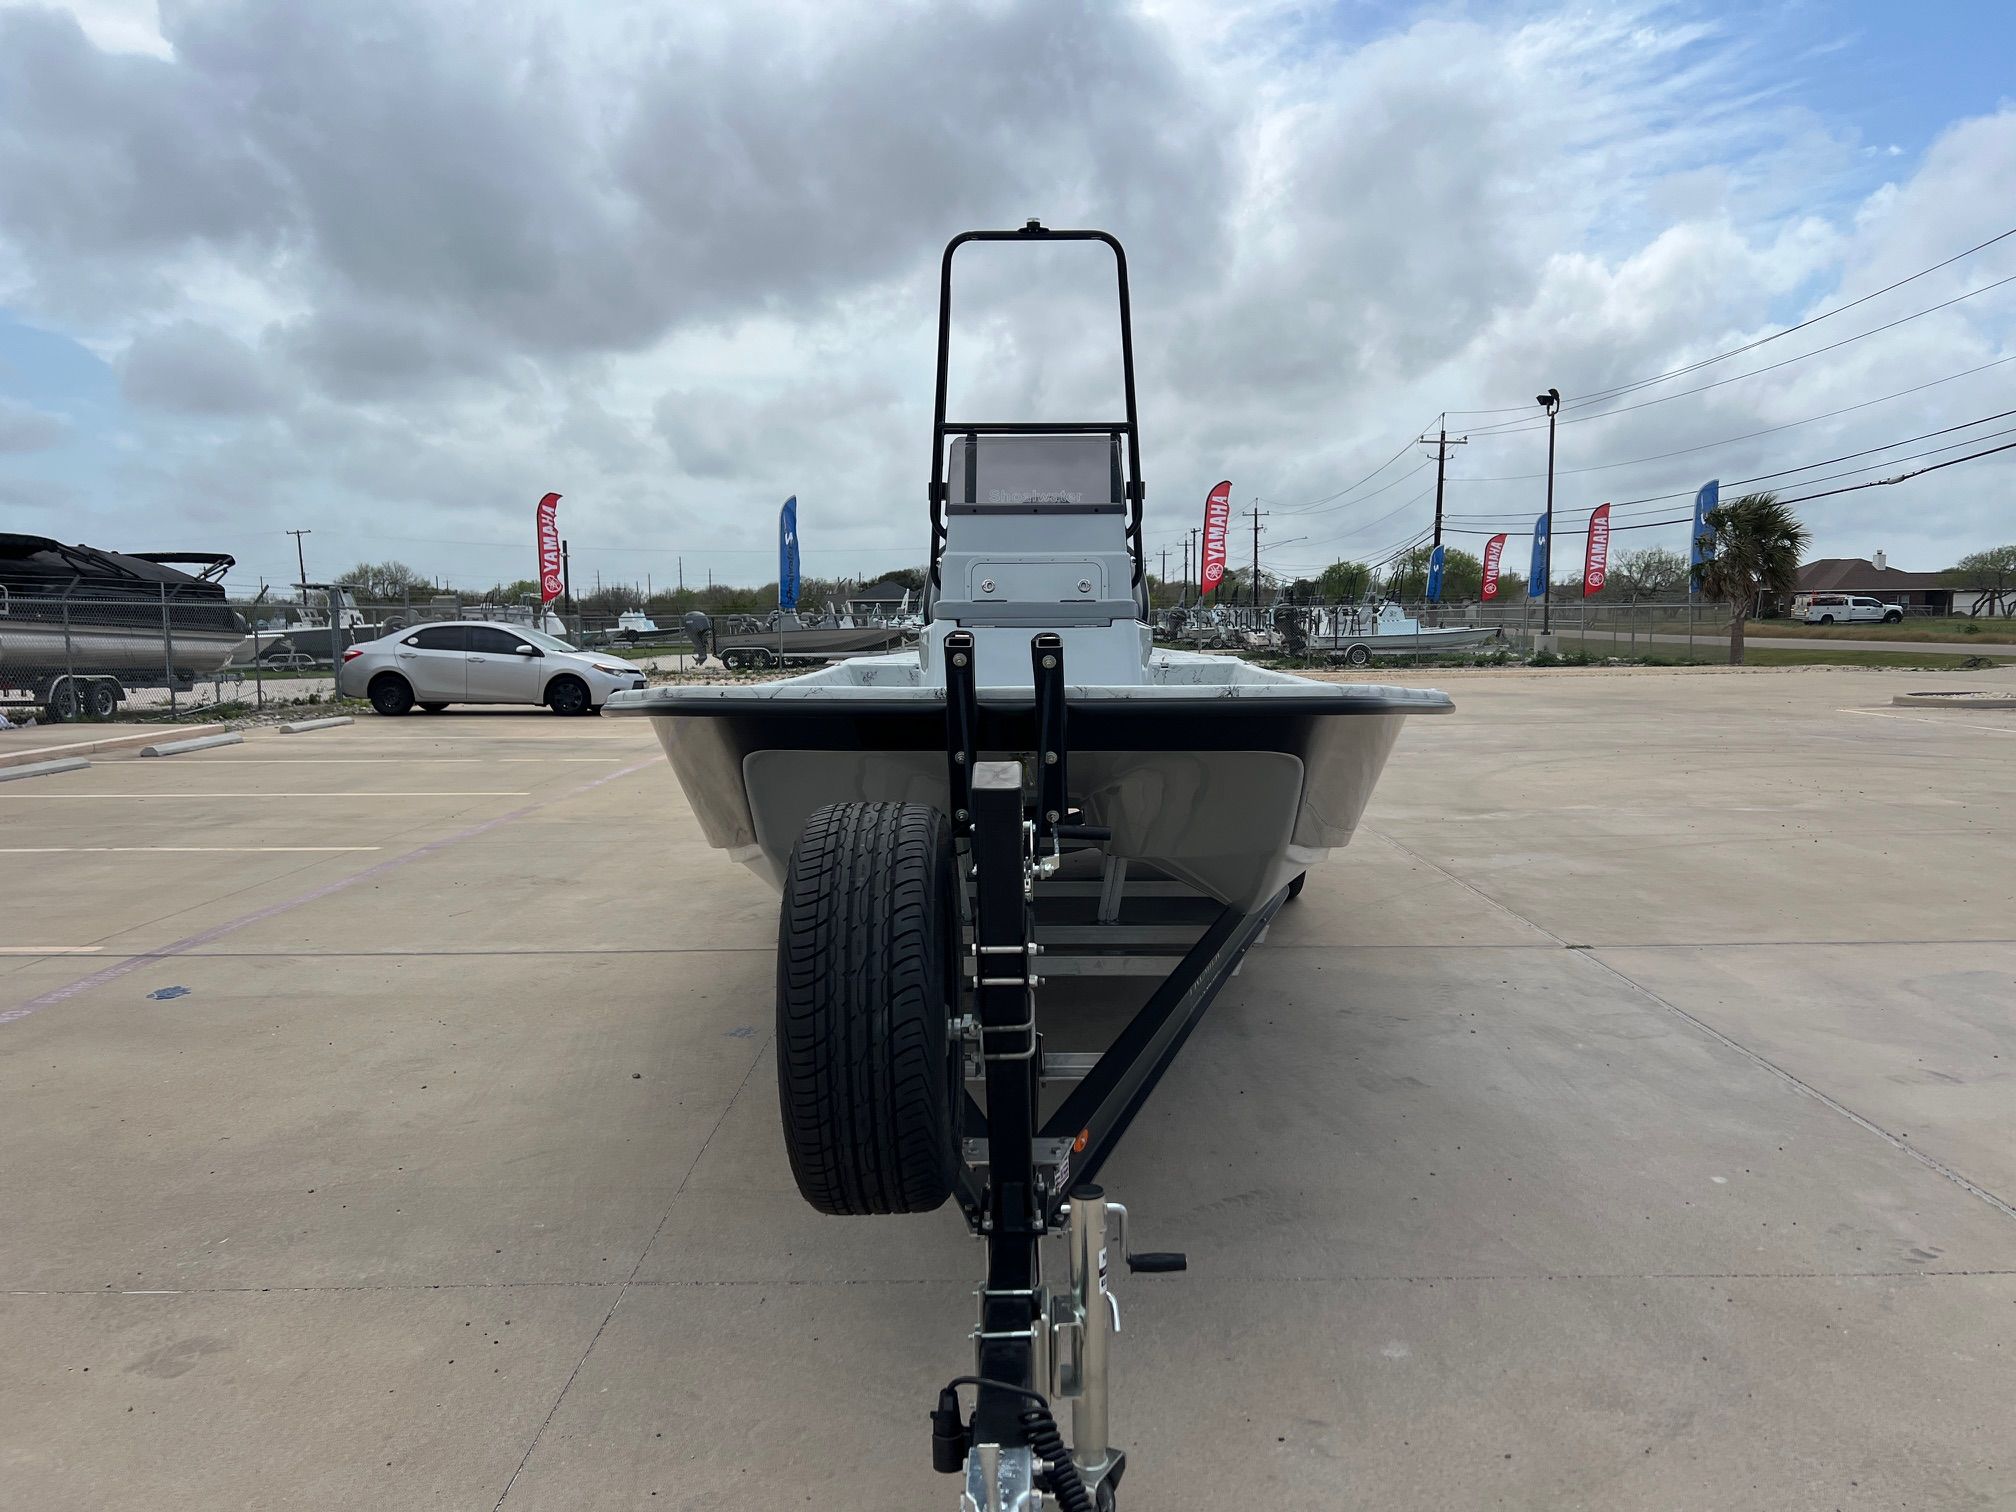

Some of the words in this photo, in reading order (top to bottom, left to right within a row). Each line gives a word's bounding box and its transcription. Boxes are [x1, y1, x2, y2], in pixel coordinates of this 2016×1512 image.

[541, 504, 559, 573] YAMAHA
[1207, 496, 1228, 561] YAMAHA
[1589, 517, 1608, 570] YAMAHA
[1486, 541, 1503, 582] YAMAHA
